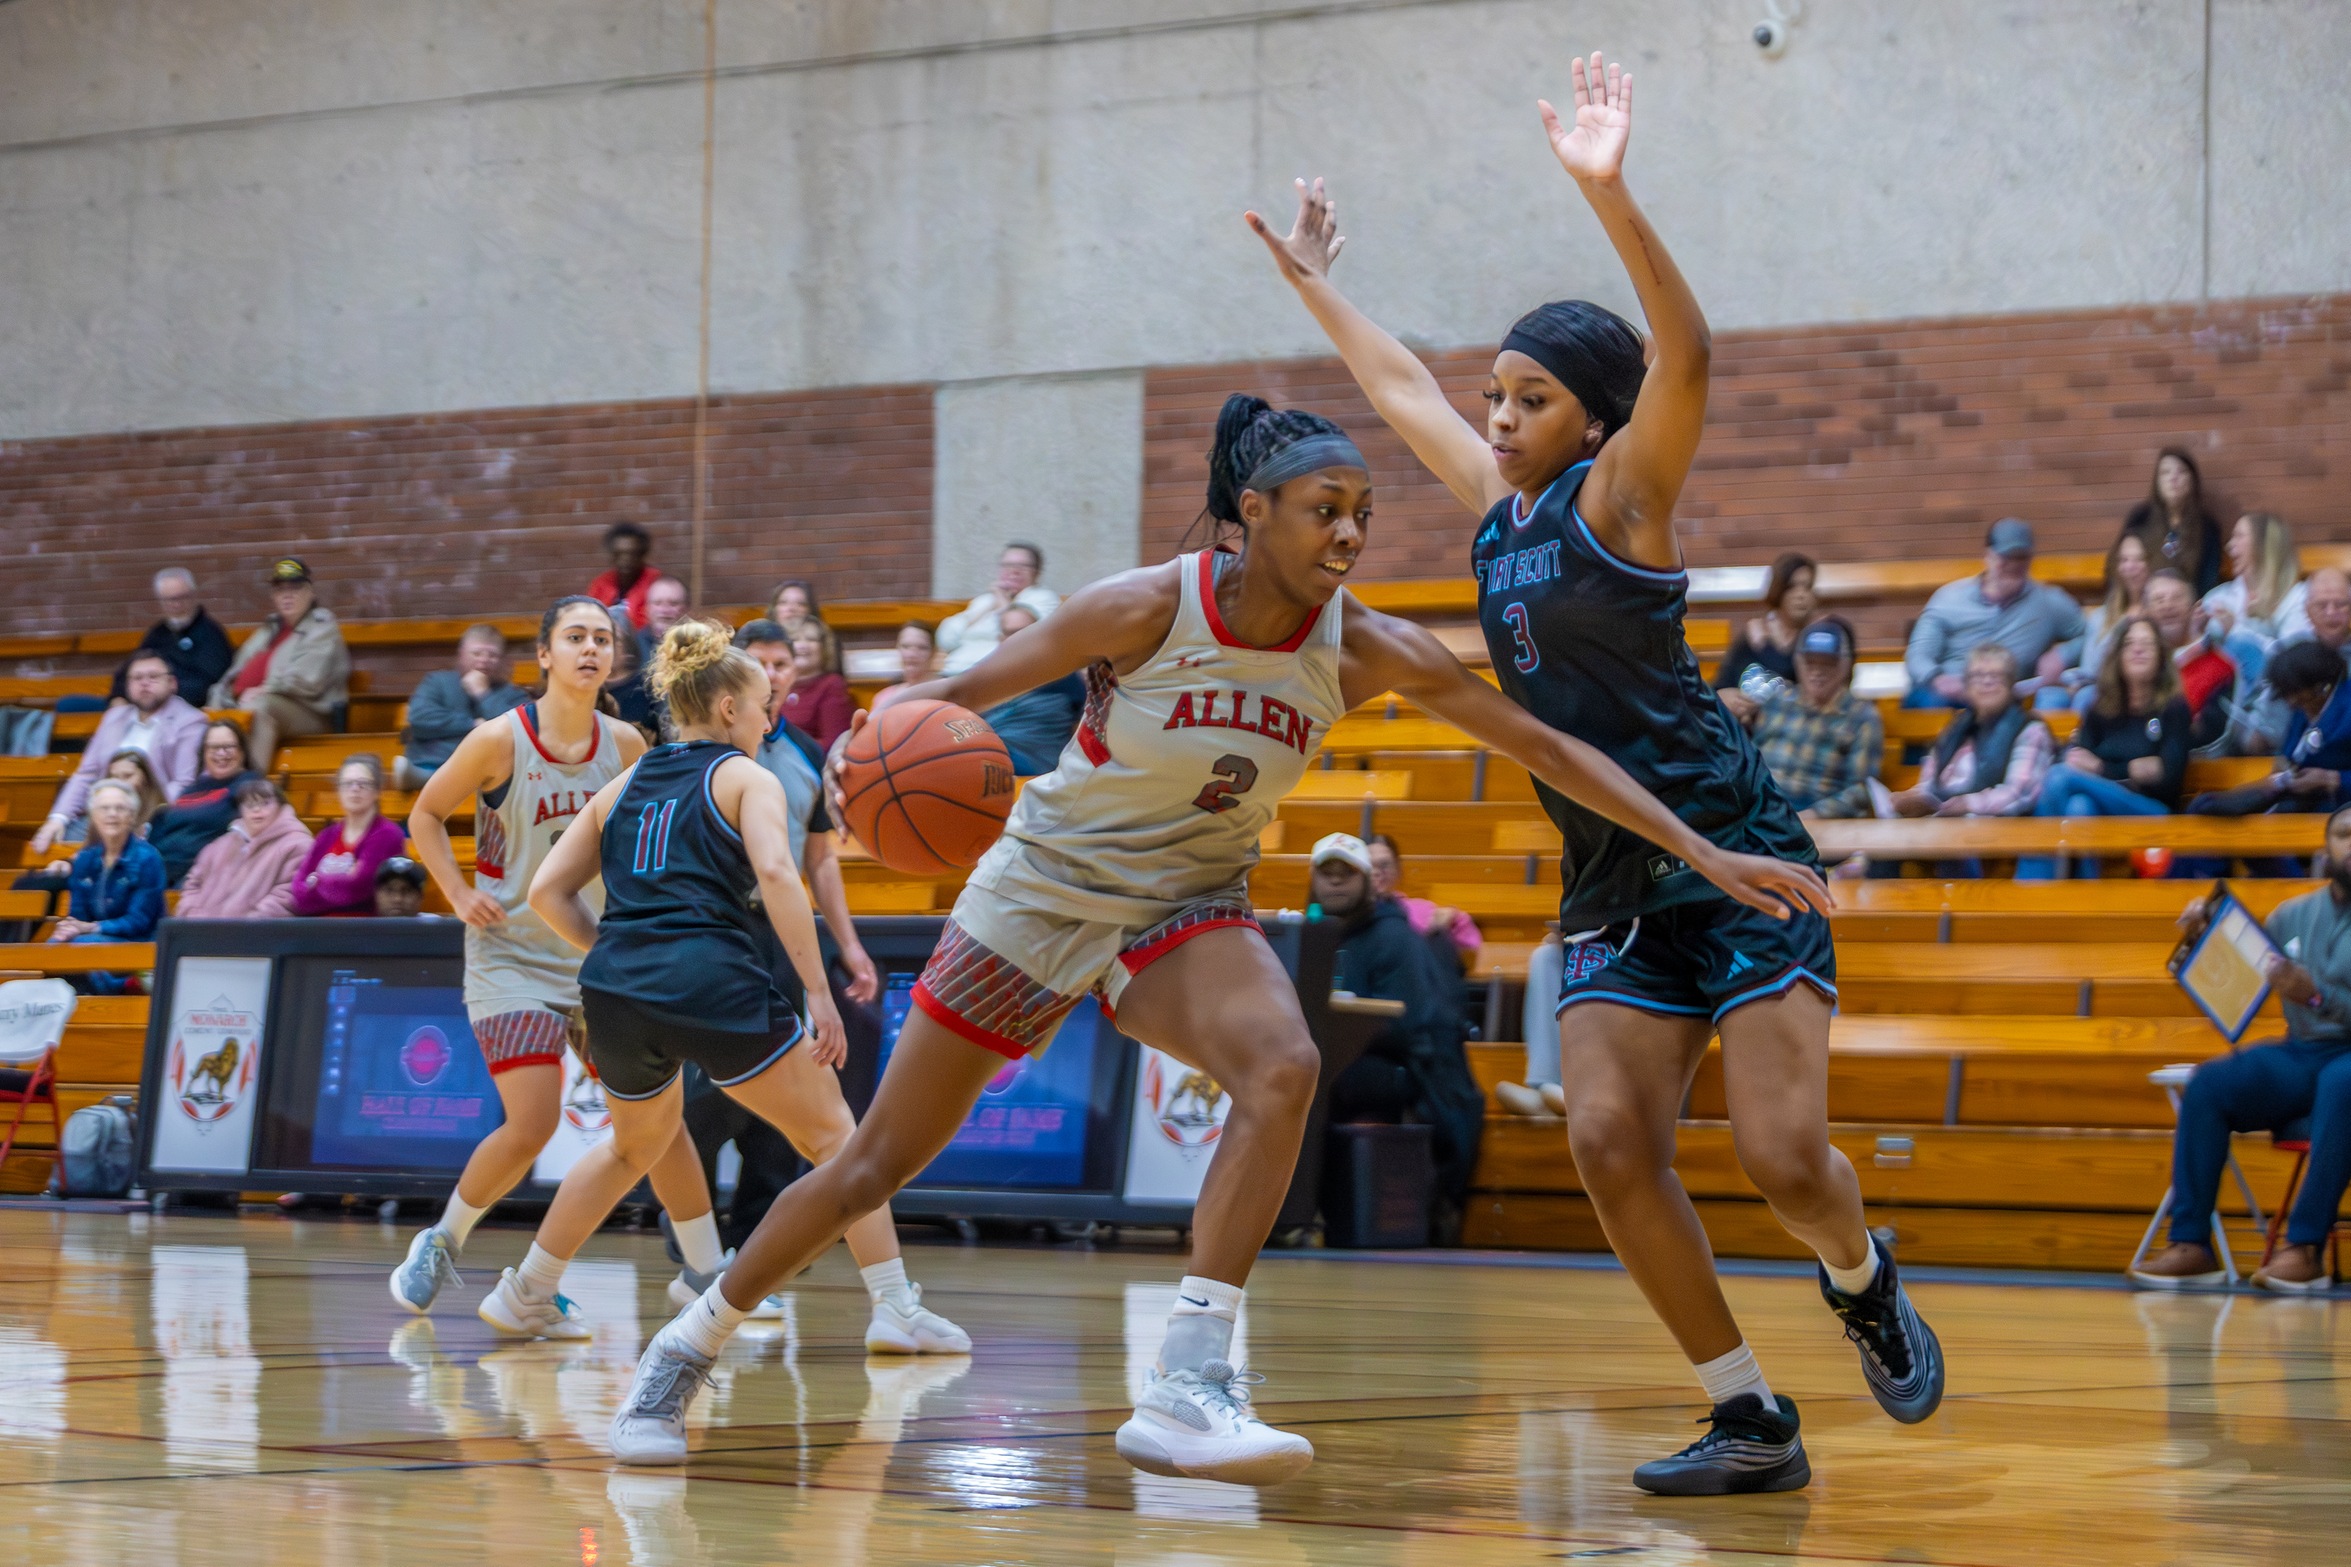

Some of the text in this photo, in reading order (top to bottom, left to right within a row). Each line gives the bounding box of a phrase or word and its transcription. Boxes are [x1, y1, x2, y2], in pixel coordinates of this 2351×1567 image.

[1502, 601, 1540, 674] 3
[1163, 690, 1313, 755] ALLEN
[1192, 754, 1259, 814] 2
[633, 798, 678, 873] 11
